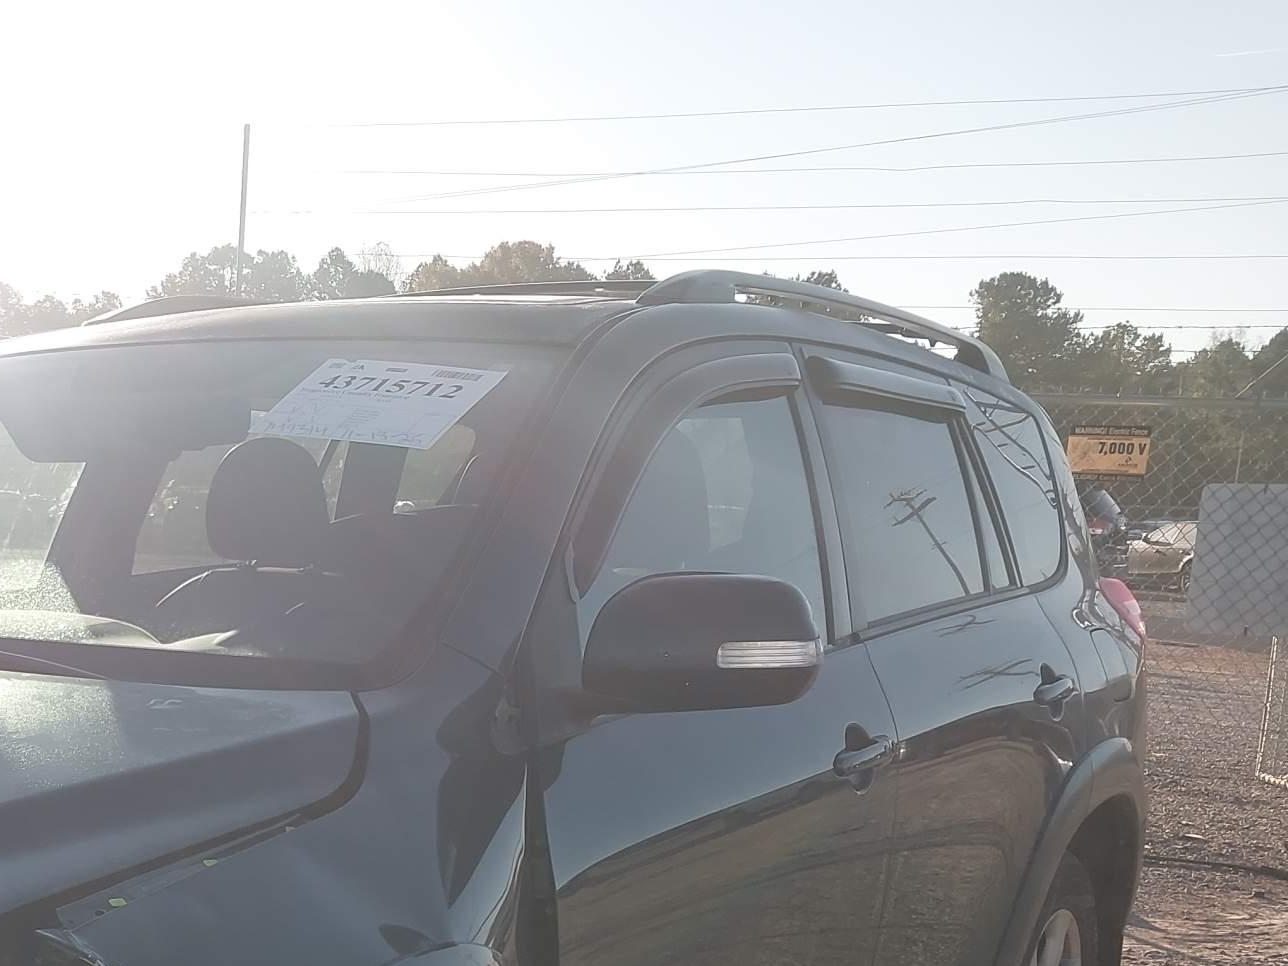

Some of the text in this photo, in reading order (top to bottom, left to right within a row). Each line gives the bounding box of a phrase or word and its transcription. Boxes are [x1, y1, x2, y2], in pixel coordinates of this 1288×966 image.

[319, 374, 464, 399] 43715712
[1098, 442, 1147, 455] 7,000 V
